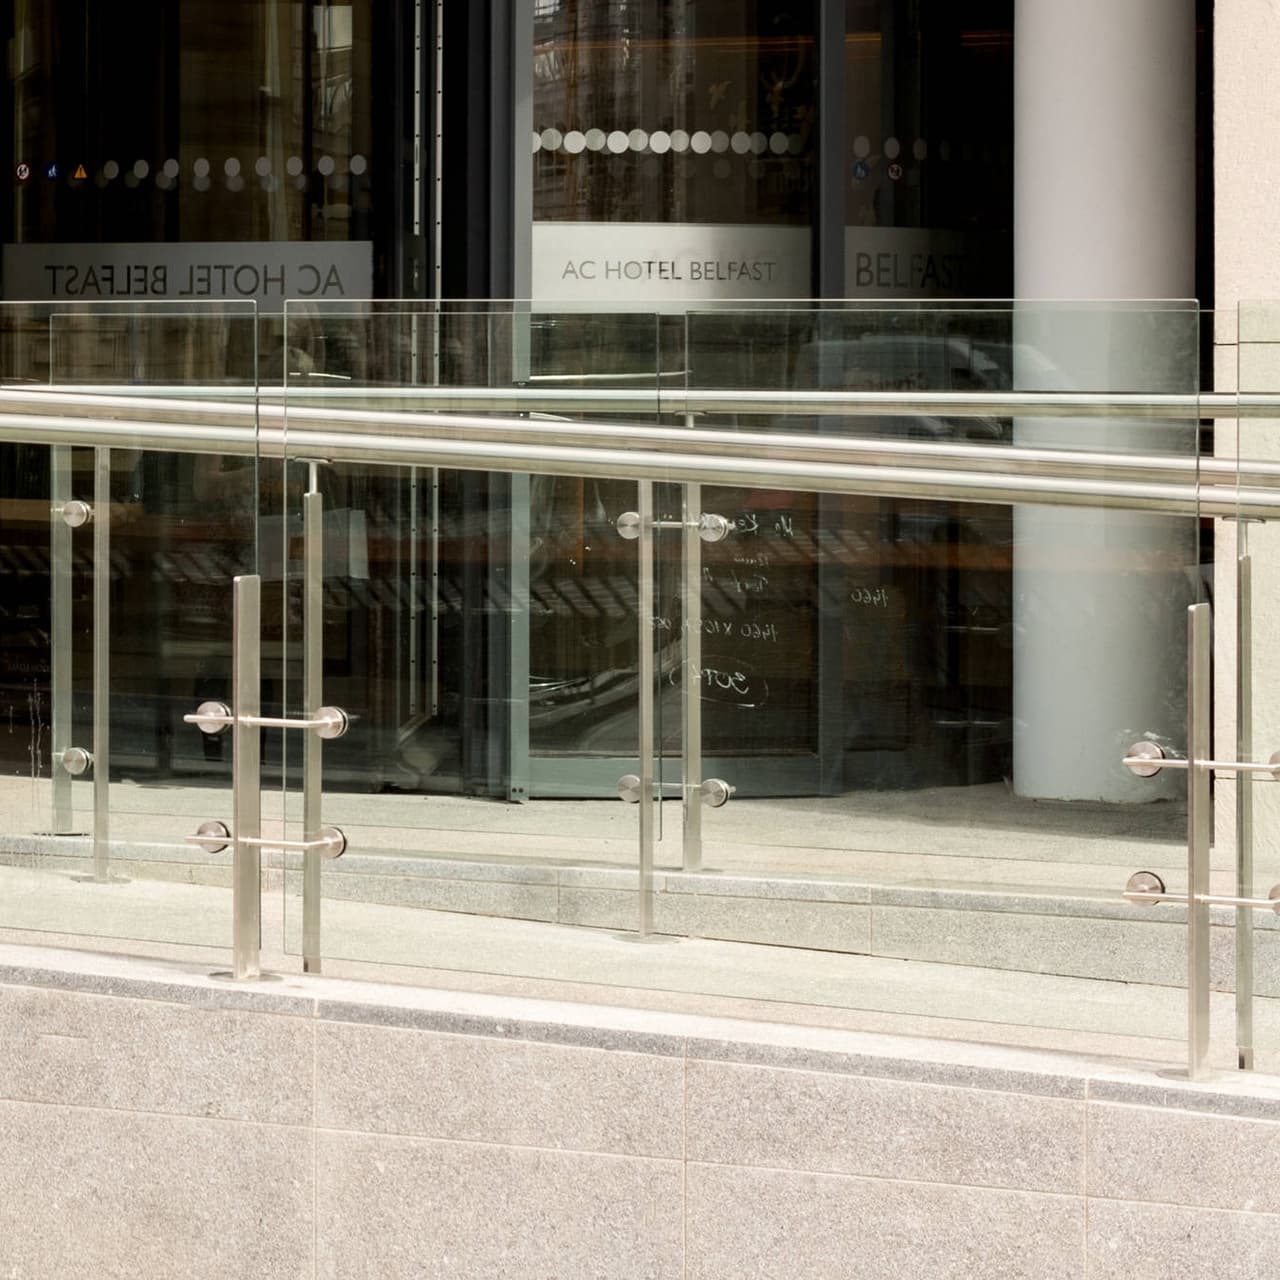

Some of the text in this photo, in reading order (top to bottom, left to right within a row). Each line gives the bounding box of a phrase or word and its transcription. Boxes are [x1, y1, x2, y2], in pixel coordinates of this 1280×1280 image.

[561, 260, 776, 281] AC HOTEL BELFAST
